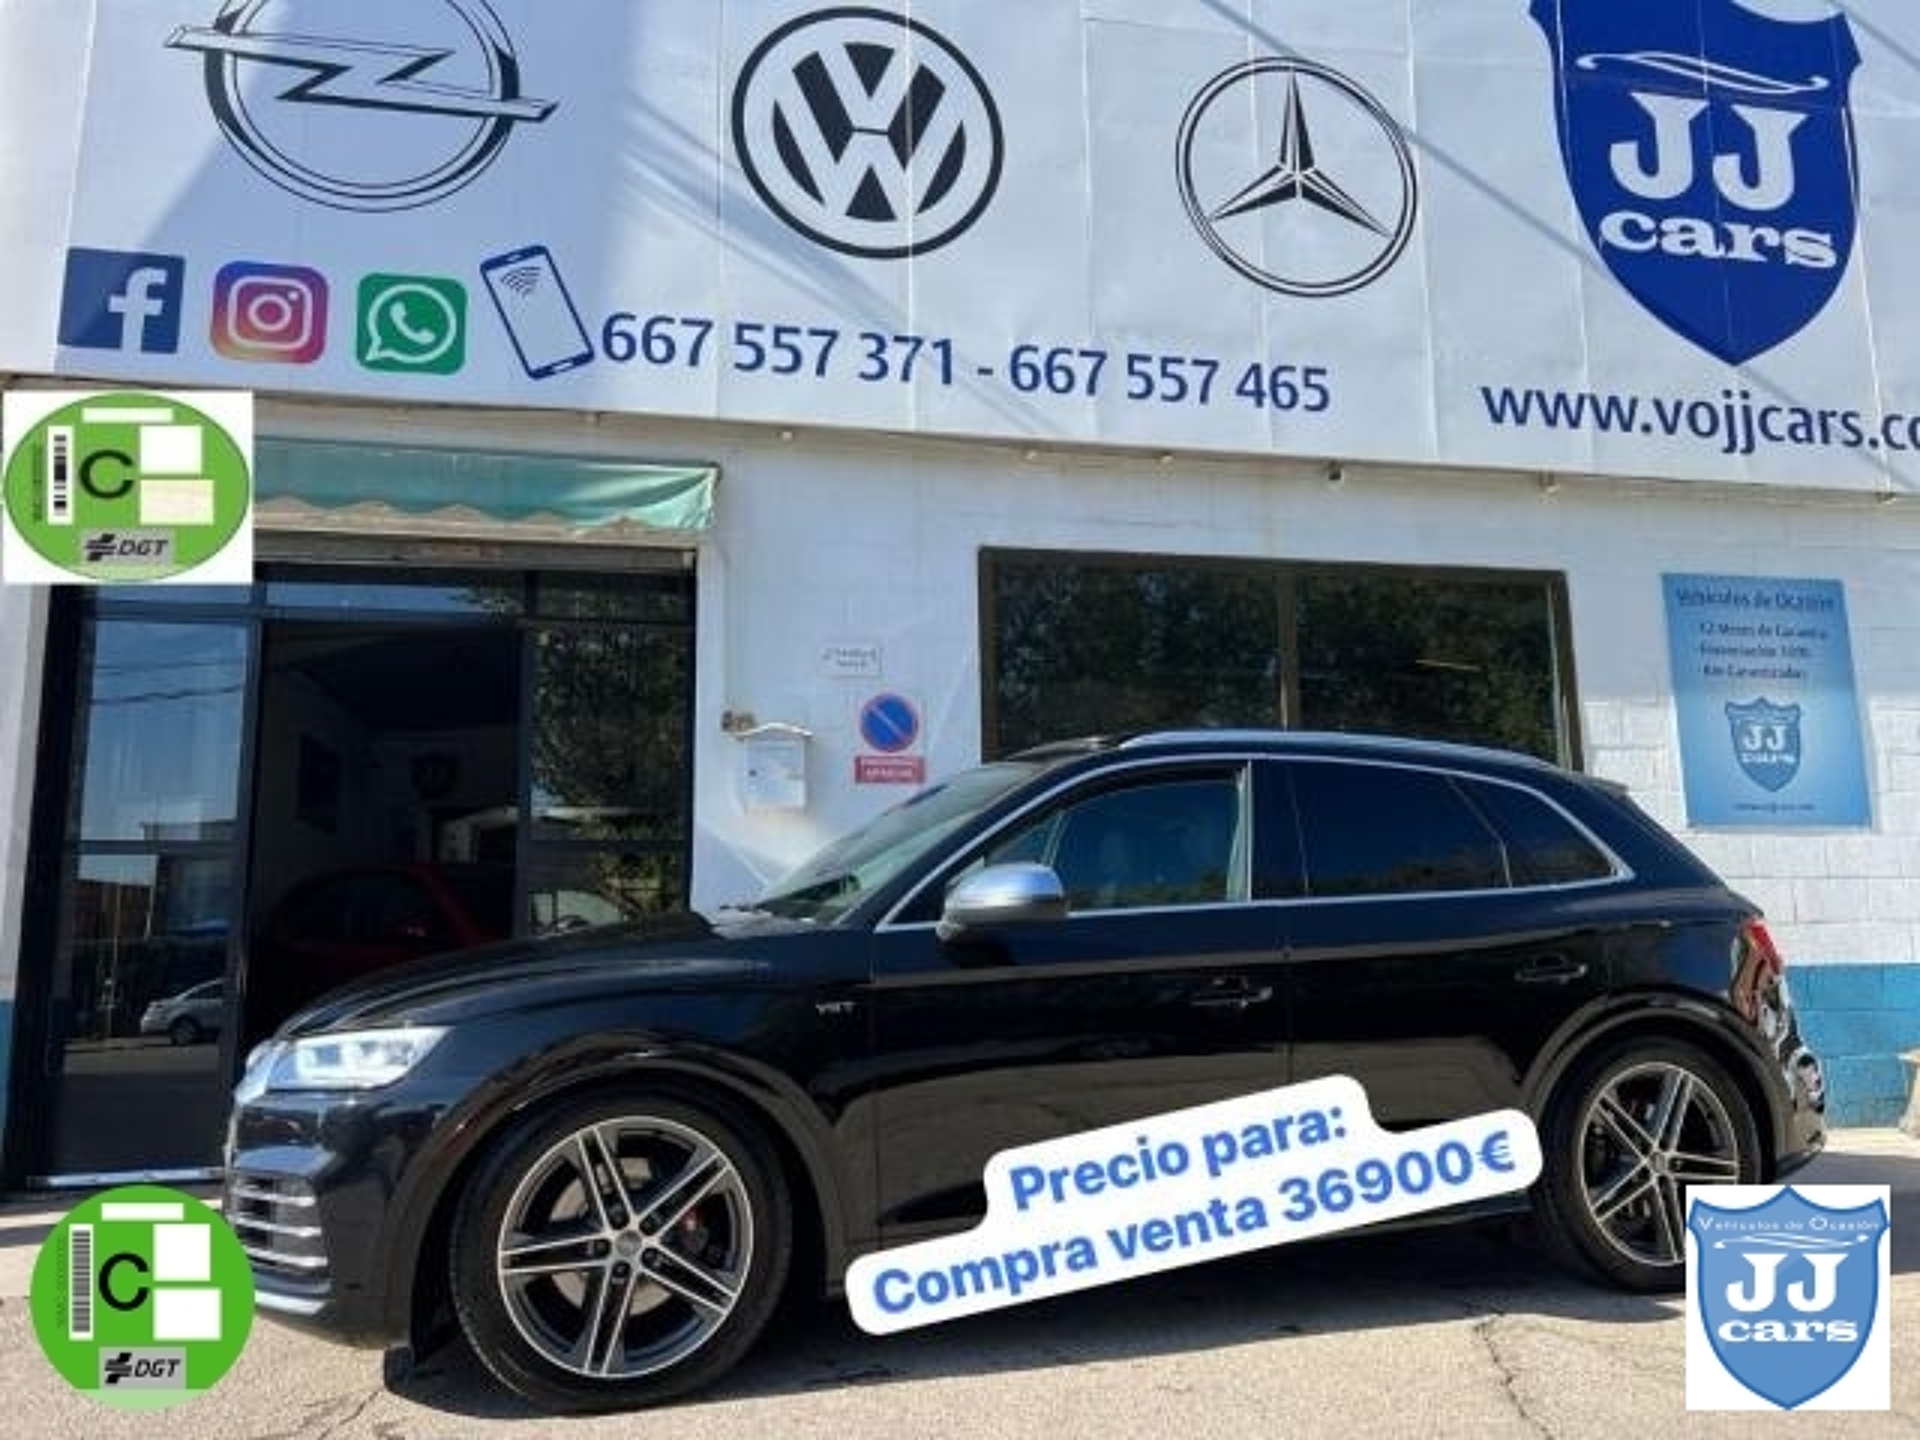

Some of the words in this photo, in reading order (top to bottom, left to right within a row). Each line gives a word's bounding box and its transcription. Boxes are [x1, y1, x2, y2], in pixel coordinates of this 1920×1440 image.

[1600, 210, 1837, 268] cars
[601, 312, 713, 367] 667
[733, 323, 840, 377] 557
[857, 332, 954, 385] 371
[1009, 344, 1107, 398] 667
[1126, 353, 1219, 406] 557
[1235, 362, 1330, 412] 465
